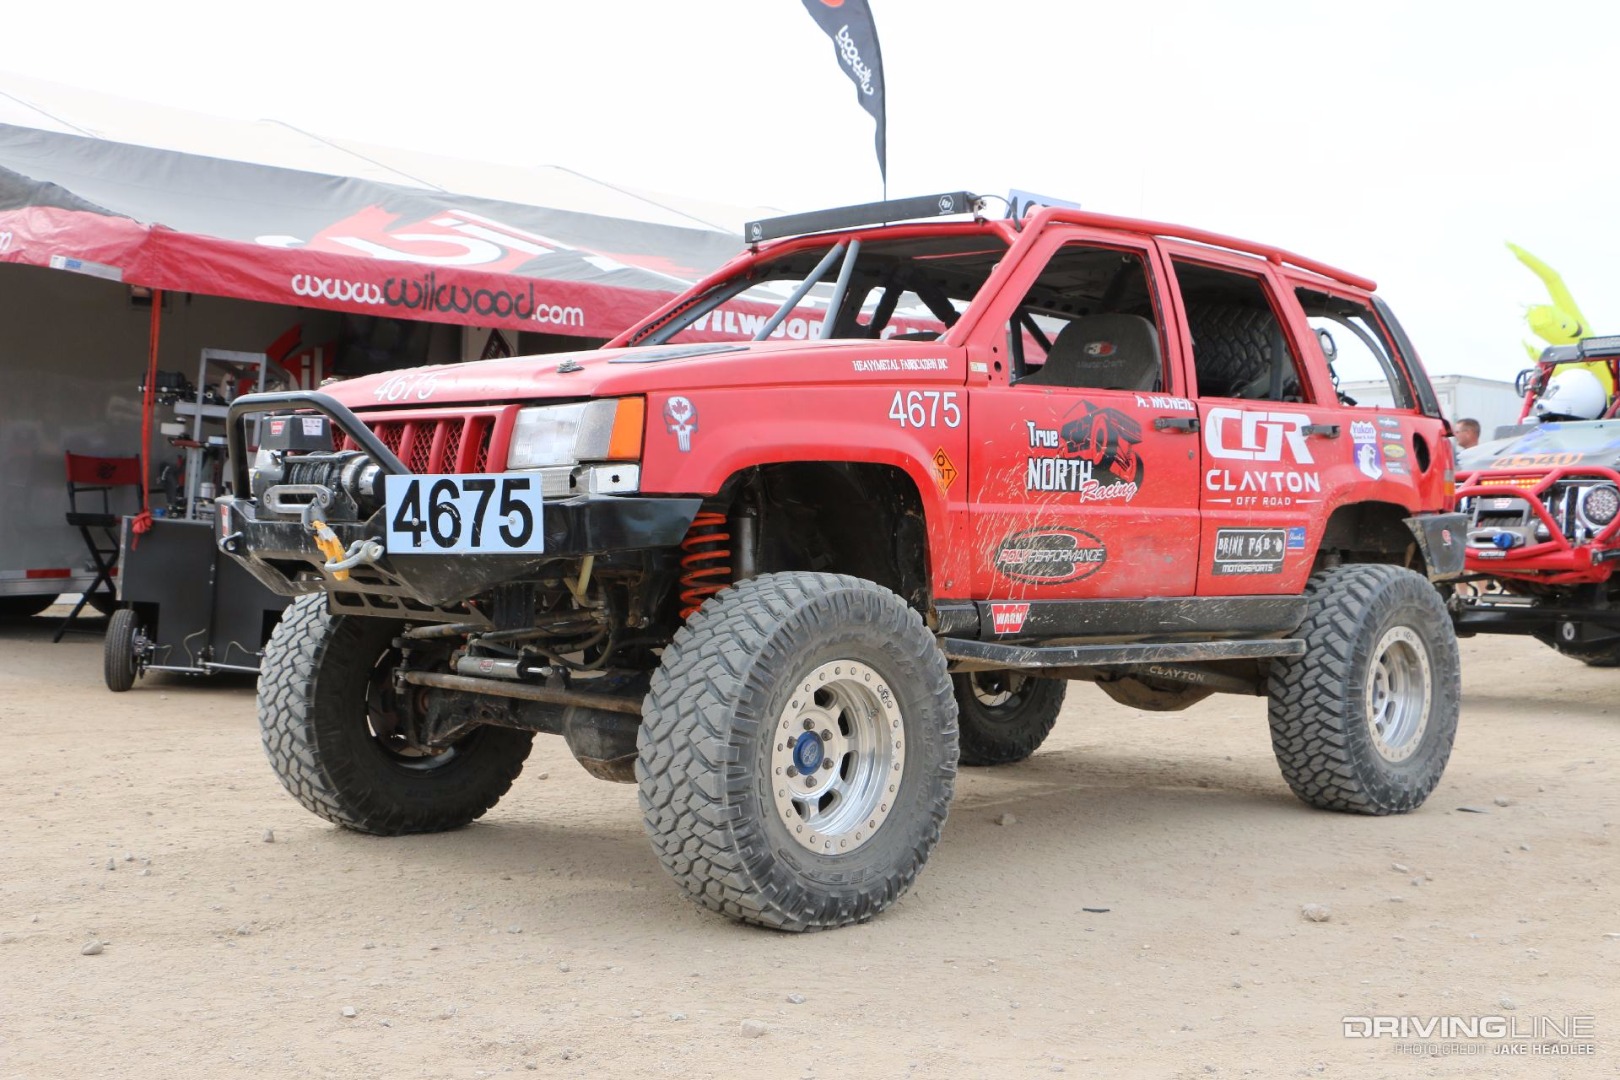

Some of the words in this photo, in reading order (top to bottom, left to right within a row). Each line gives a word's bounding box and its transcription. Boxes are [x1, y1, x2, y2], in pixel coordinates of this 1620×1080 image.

[291, 271, 584, 327] www.wilwood.com
[373, 371, 449, 402] 4675
[888, 390, 961, 428] 4675
[1027, 421, 1059, 447] True
[1027, 457, 1093, 491] NORTH
[1205, 469, 1321, 493] CLAYTON
[1080, 479, 1138, 503] Racing
[1236, 497, 1257, 506] OFF
[1262, 497, 1292, 506] ROAD
[392, 478, 534, 549] 4675
[1221, 563, 1274, 574] MOTORSPORTS
[996, 612, 1023, 625] WARN
[1149, 665, 1206, 682] CLAYTON
